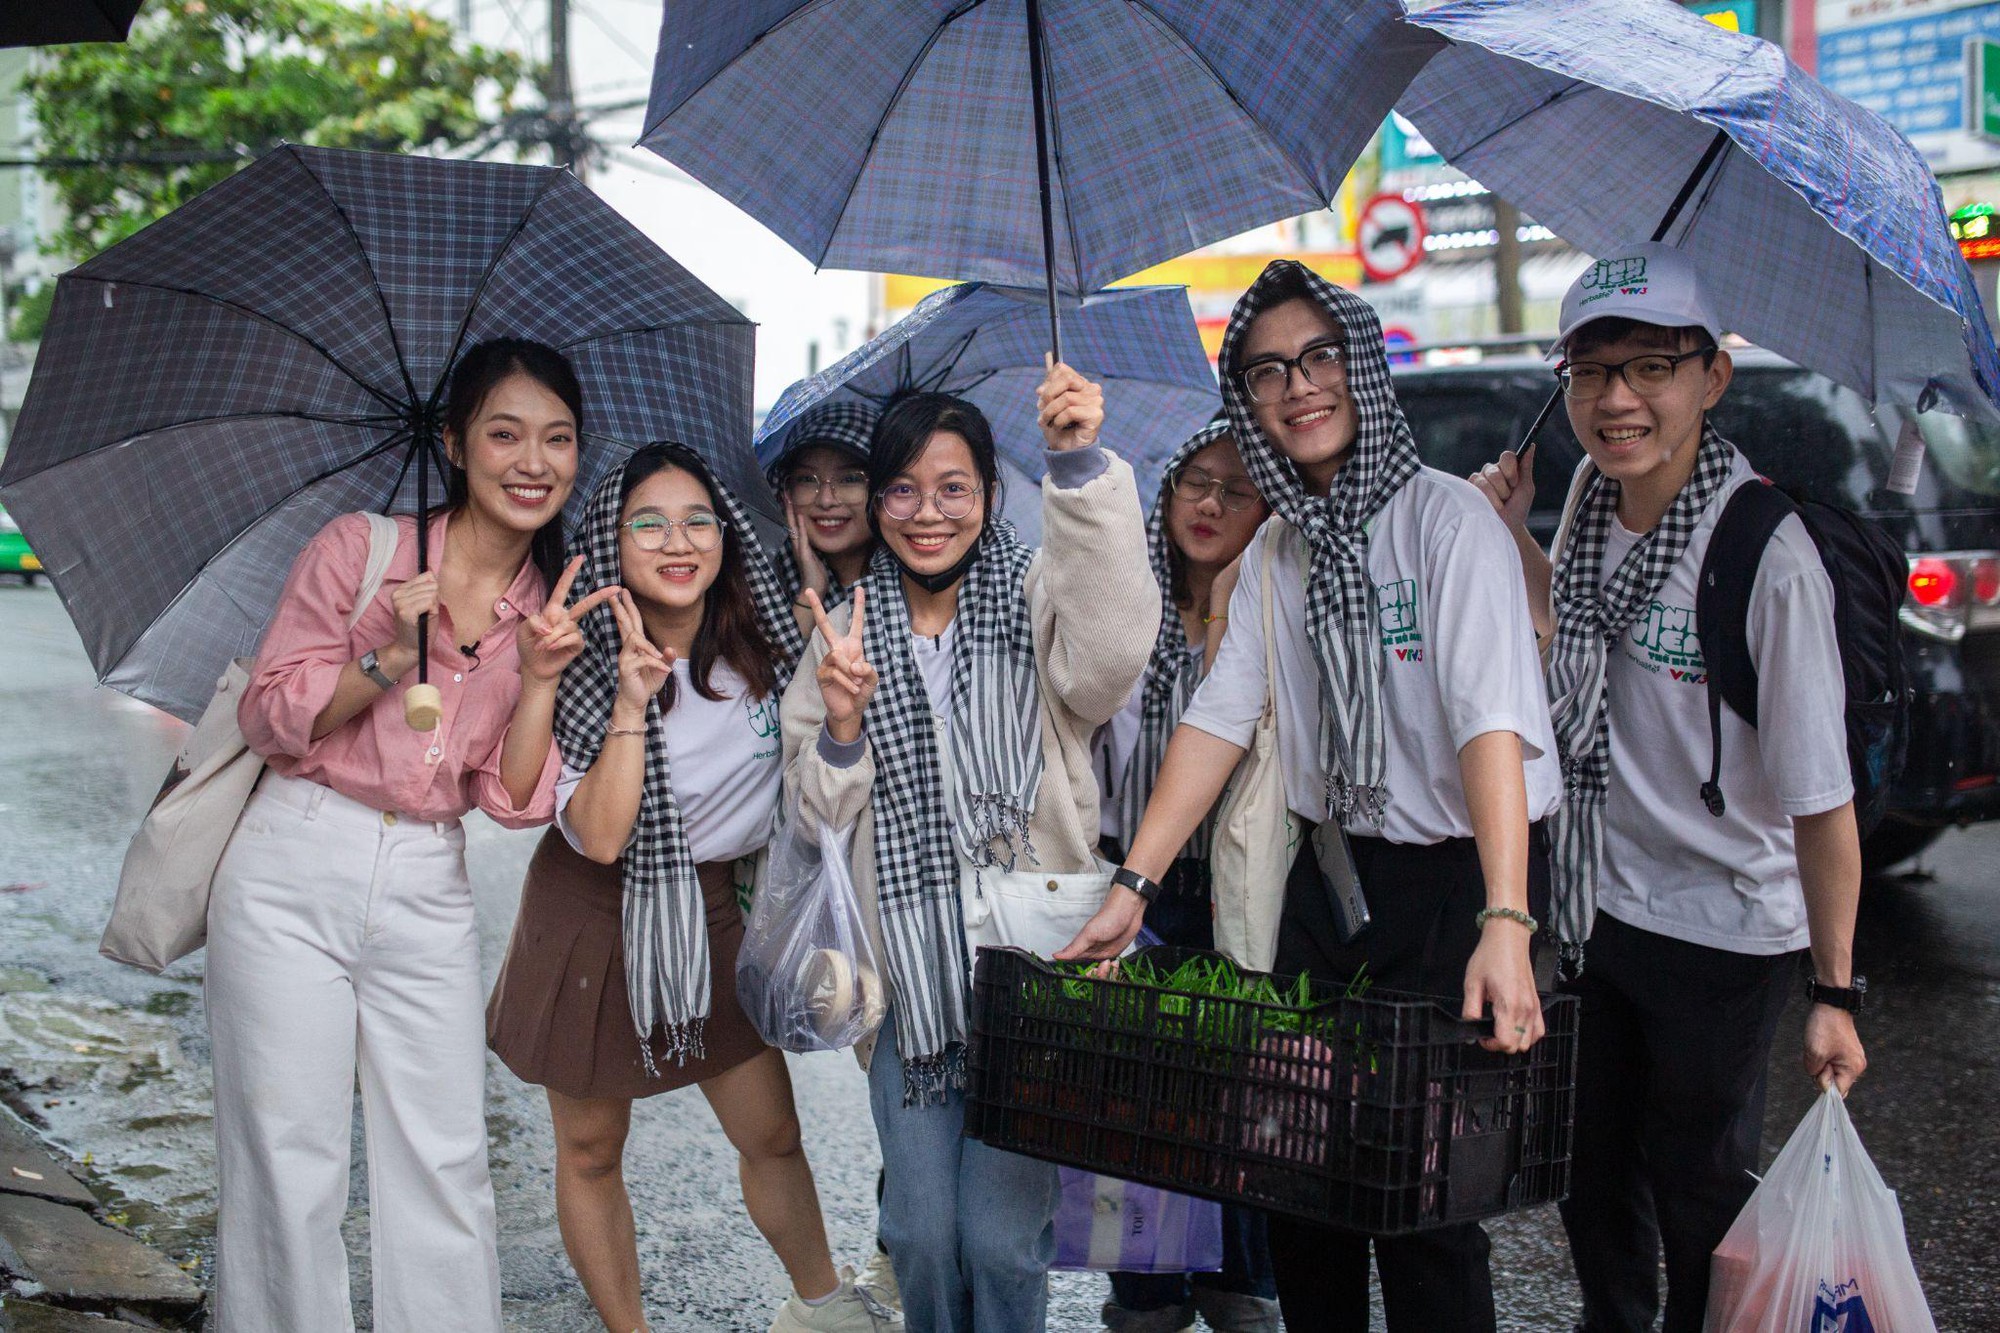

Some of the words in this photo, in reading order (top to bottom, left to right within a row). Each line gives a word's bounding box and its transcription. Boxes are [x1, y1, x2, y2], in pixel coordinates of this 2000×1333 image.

[1620, 286, 1648, 295] VTV3
[1395, 648, 1423, 662] VTV3
[1669, 667, 1708, 684] VTV3
